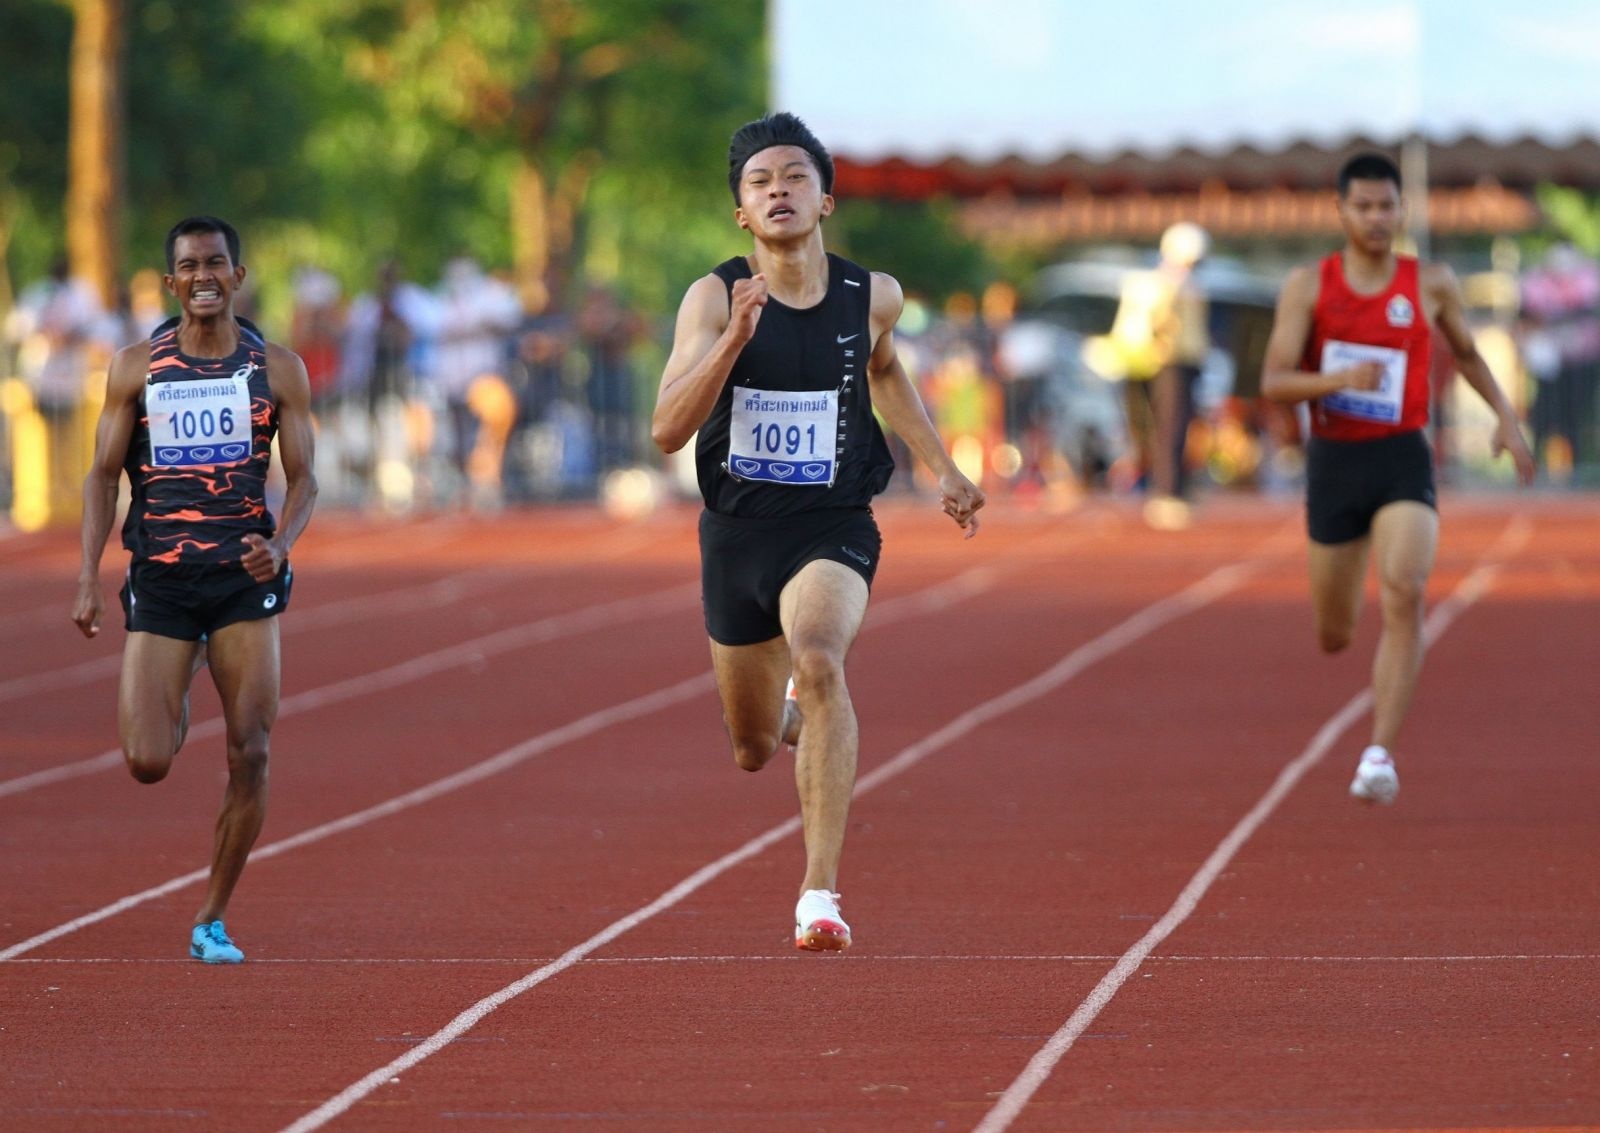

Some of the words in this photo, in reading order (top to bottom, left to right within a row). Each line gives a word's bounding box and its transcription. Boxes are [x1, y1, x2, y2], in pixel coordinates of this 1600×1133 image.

[744, 392, 829, 413] ศรีสะเกษเกมส์
[168, 406, 235, 440] 1006
[751, 422, 816, 456] 1091
[835, 406, 849, 464] RUNN
